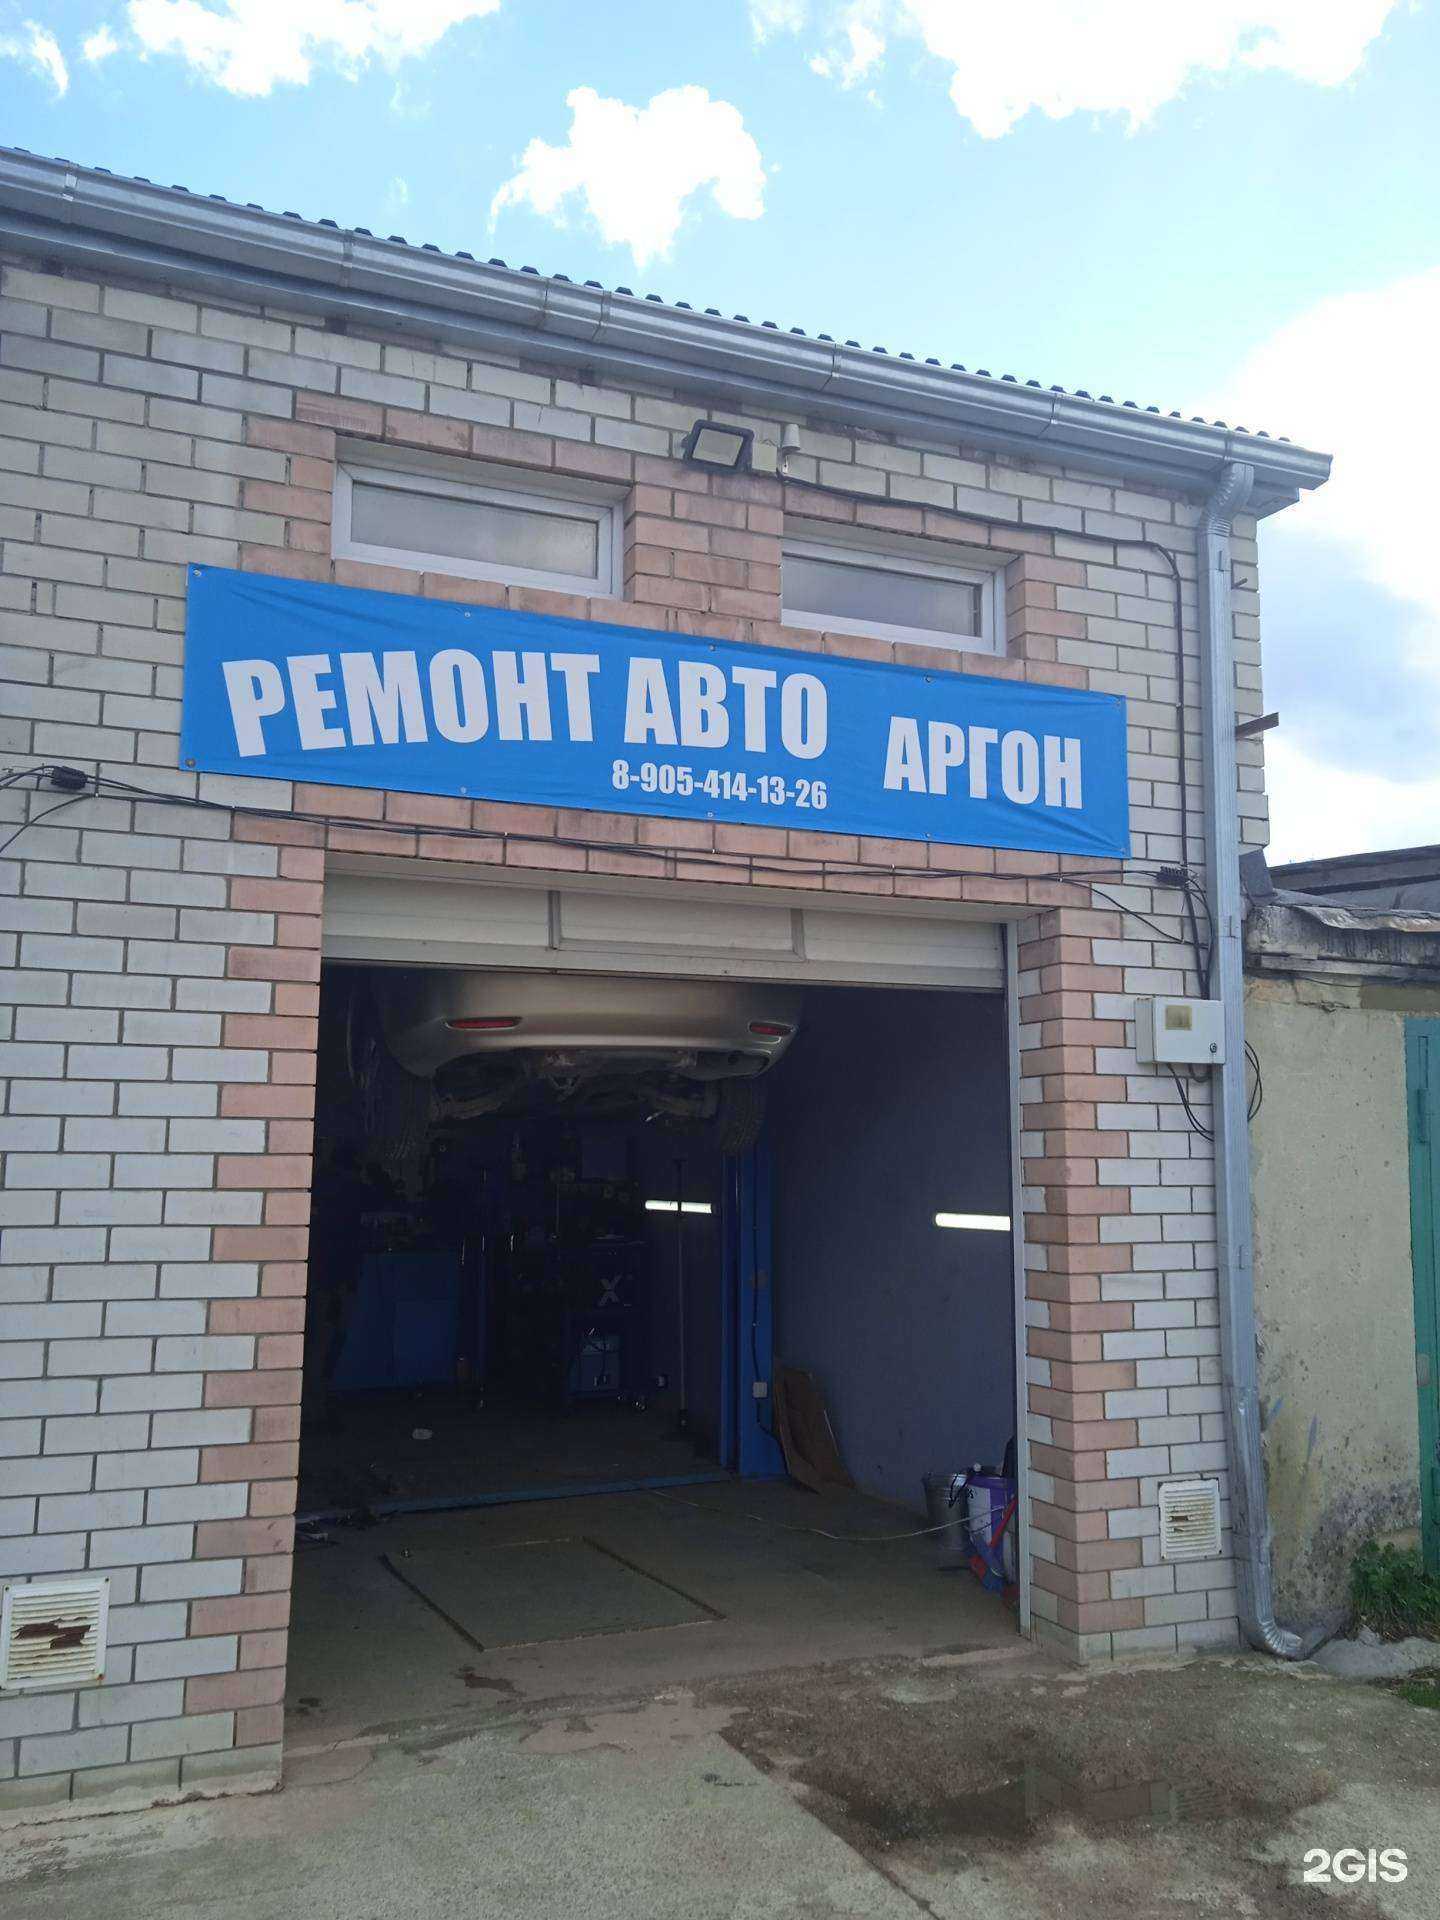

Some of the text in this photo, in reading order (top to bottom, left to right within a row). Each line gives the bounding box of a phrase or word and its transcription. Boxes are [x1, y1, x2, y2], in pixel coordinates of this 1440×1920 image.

[222, 648, 828, 760] РЕМОНТ АВТО
[612, 759, 828, 811] 8-905-414-13-26
[883, 715, 1083, 810] АРГОН
